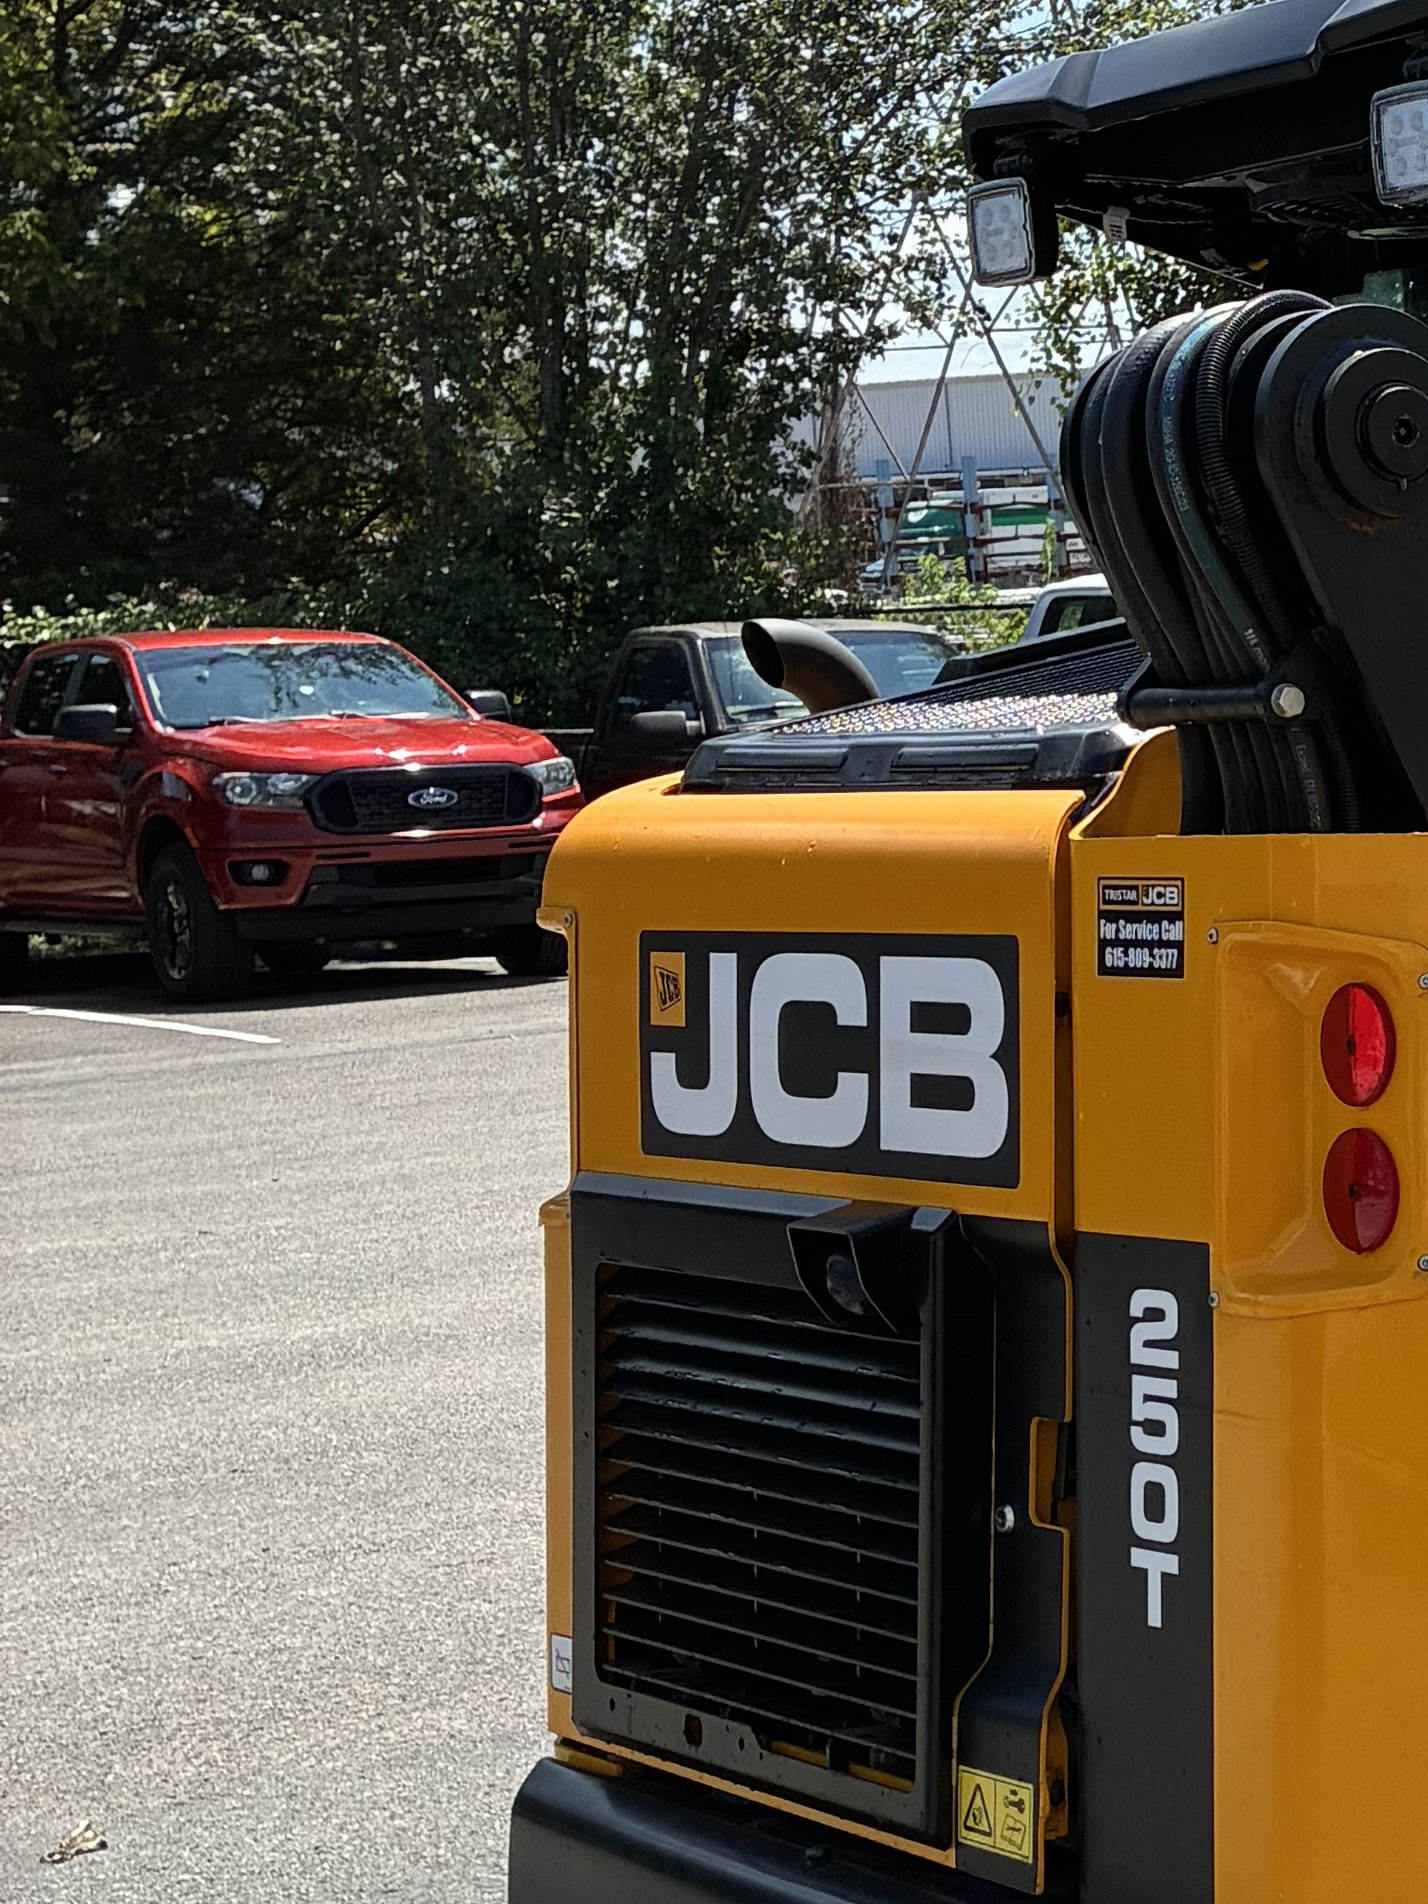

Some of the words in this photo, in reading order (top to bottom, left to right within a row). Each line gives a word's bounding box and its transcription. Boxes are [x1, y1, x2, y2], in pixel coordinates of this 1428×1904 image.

[1104, 889, 1138, 902] TRISTAR
[1143, 886, 1179, 905] JCB
[1100, 918, 1117, 940] For
[1118, 919, 1160, 941] Service
[1161, 920, 1184, 942] Call
[659, 969, 680, 1007] JCB
[650, 952, 1009, 1159] JCB
[1129, 1288, 1180, 1629] 250T
